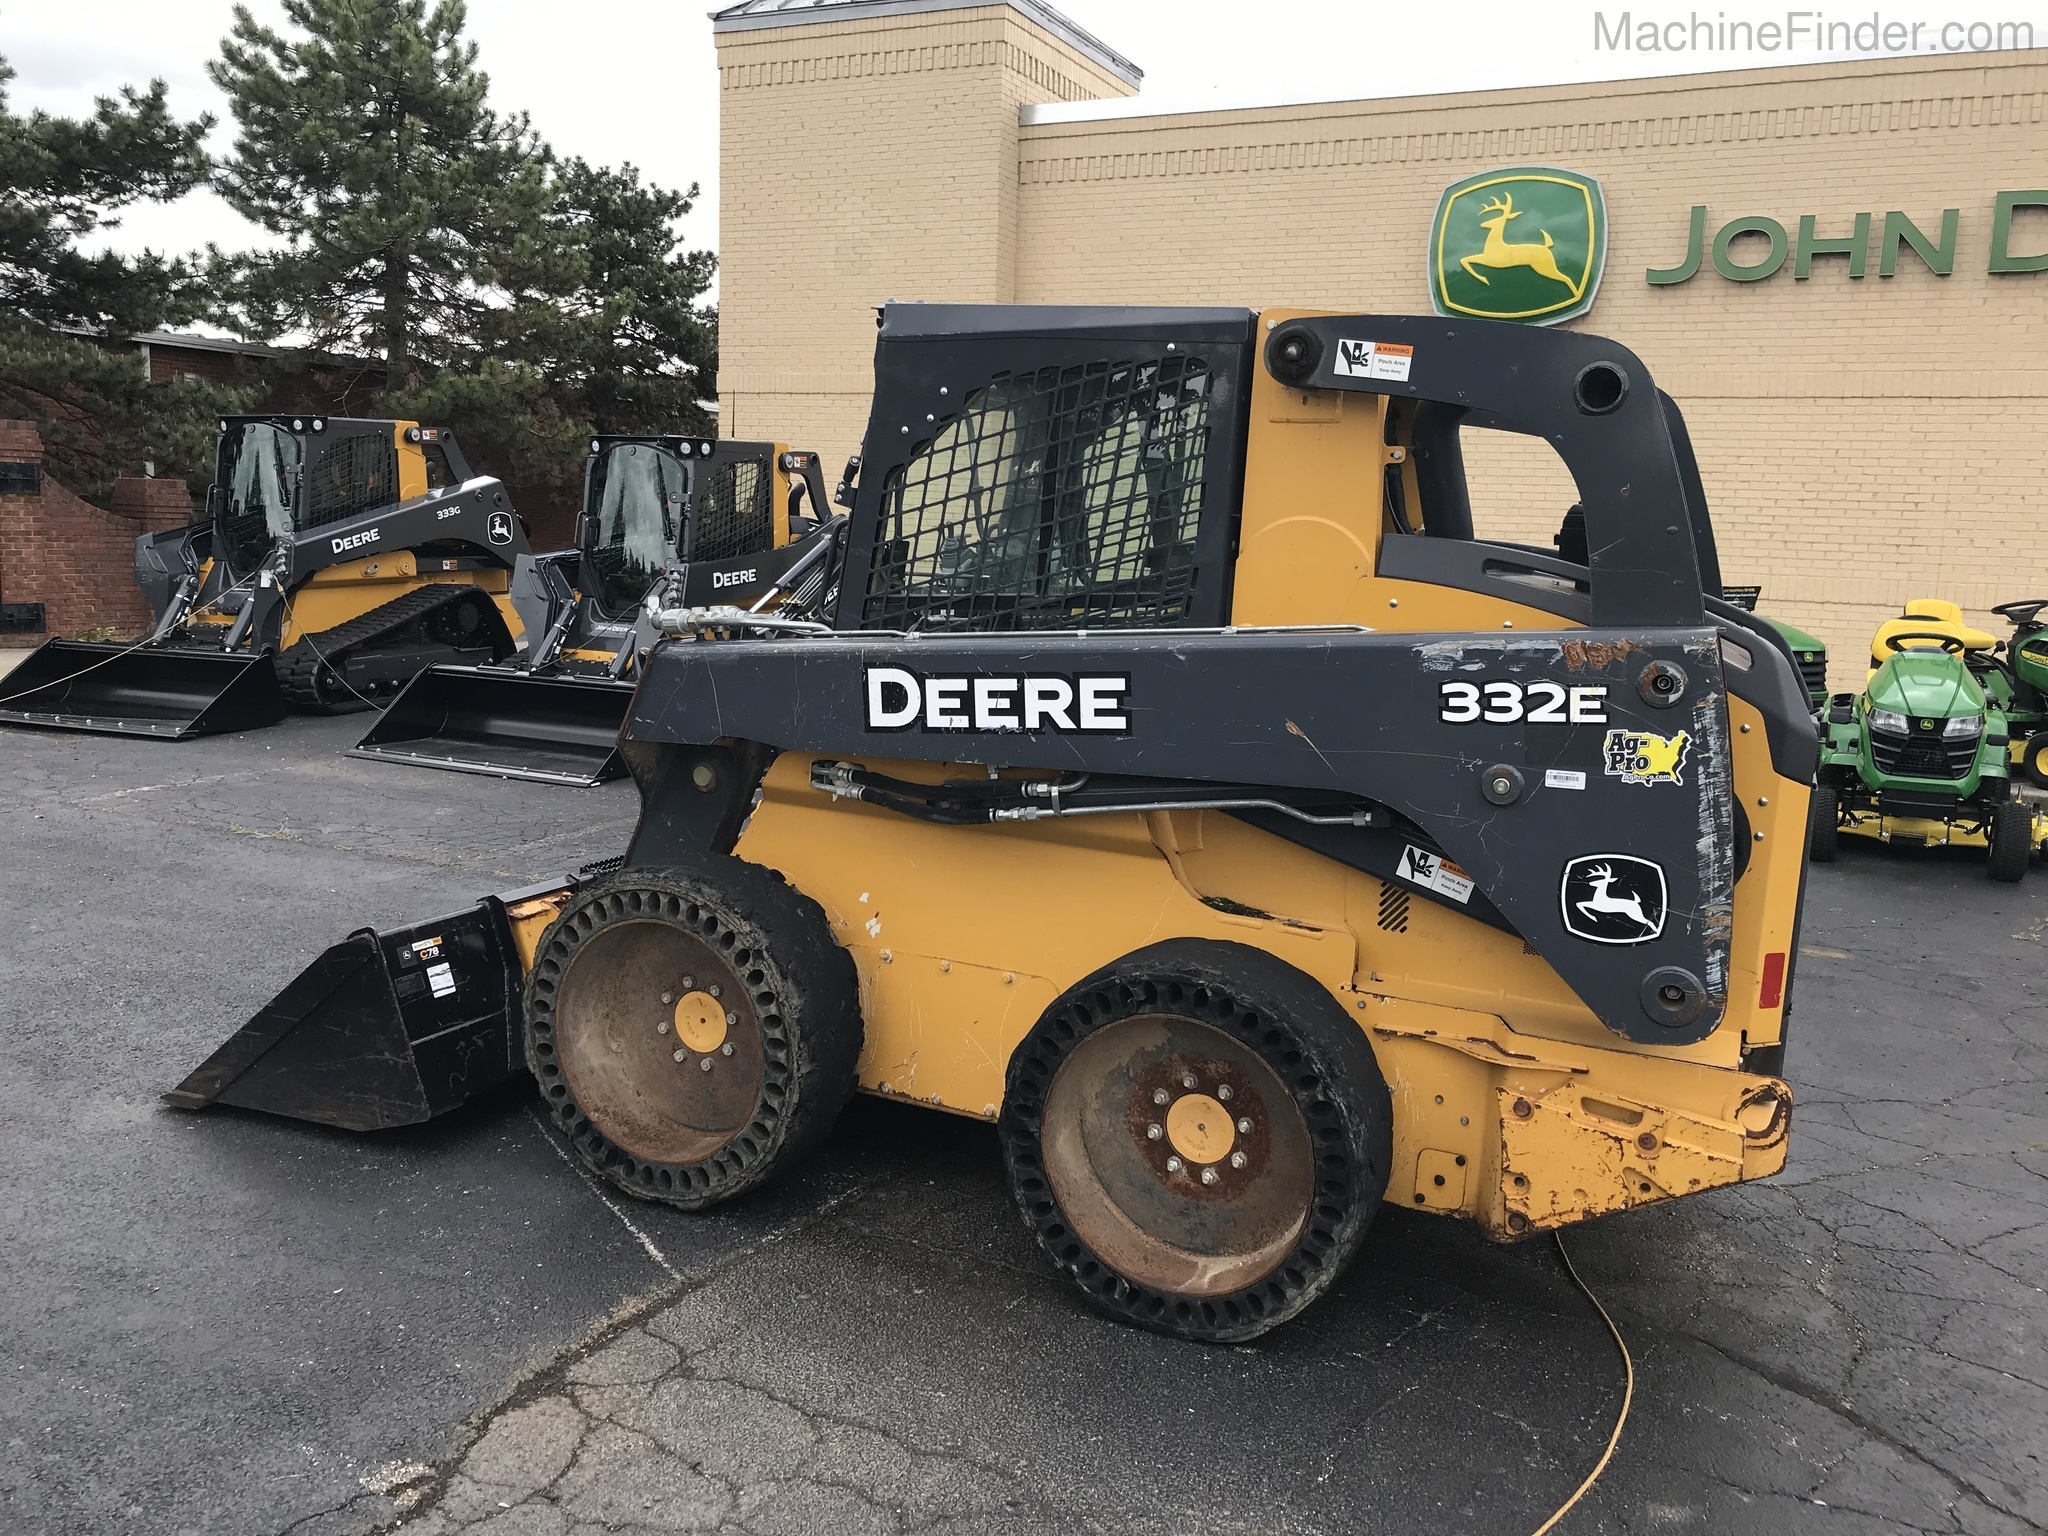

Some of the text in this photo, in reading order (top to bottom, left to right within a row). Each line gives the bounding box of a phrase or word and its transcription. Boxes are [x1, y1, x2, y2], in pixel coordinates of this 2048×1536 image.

[1646, 205, 1960, 285] JOHN
[1382, 346, 1410, 355] WARNING
[1377, 358, 1393, 366] Pinch
[436, 505, 462, 521] 333G
[331, 528, 381, 555] DEERE
[712, 568, 758, 590] DEERE
[867, 667, 1127, 730] DEERE
[1441, 682, 1607, 723] 332E
[1608, 732, 1648, 755] Ag-
[1608, 752, 1649, 771] Pro
[1441, 874, 1456, 884] Pinch
[420, 946, 440, 959] C78
